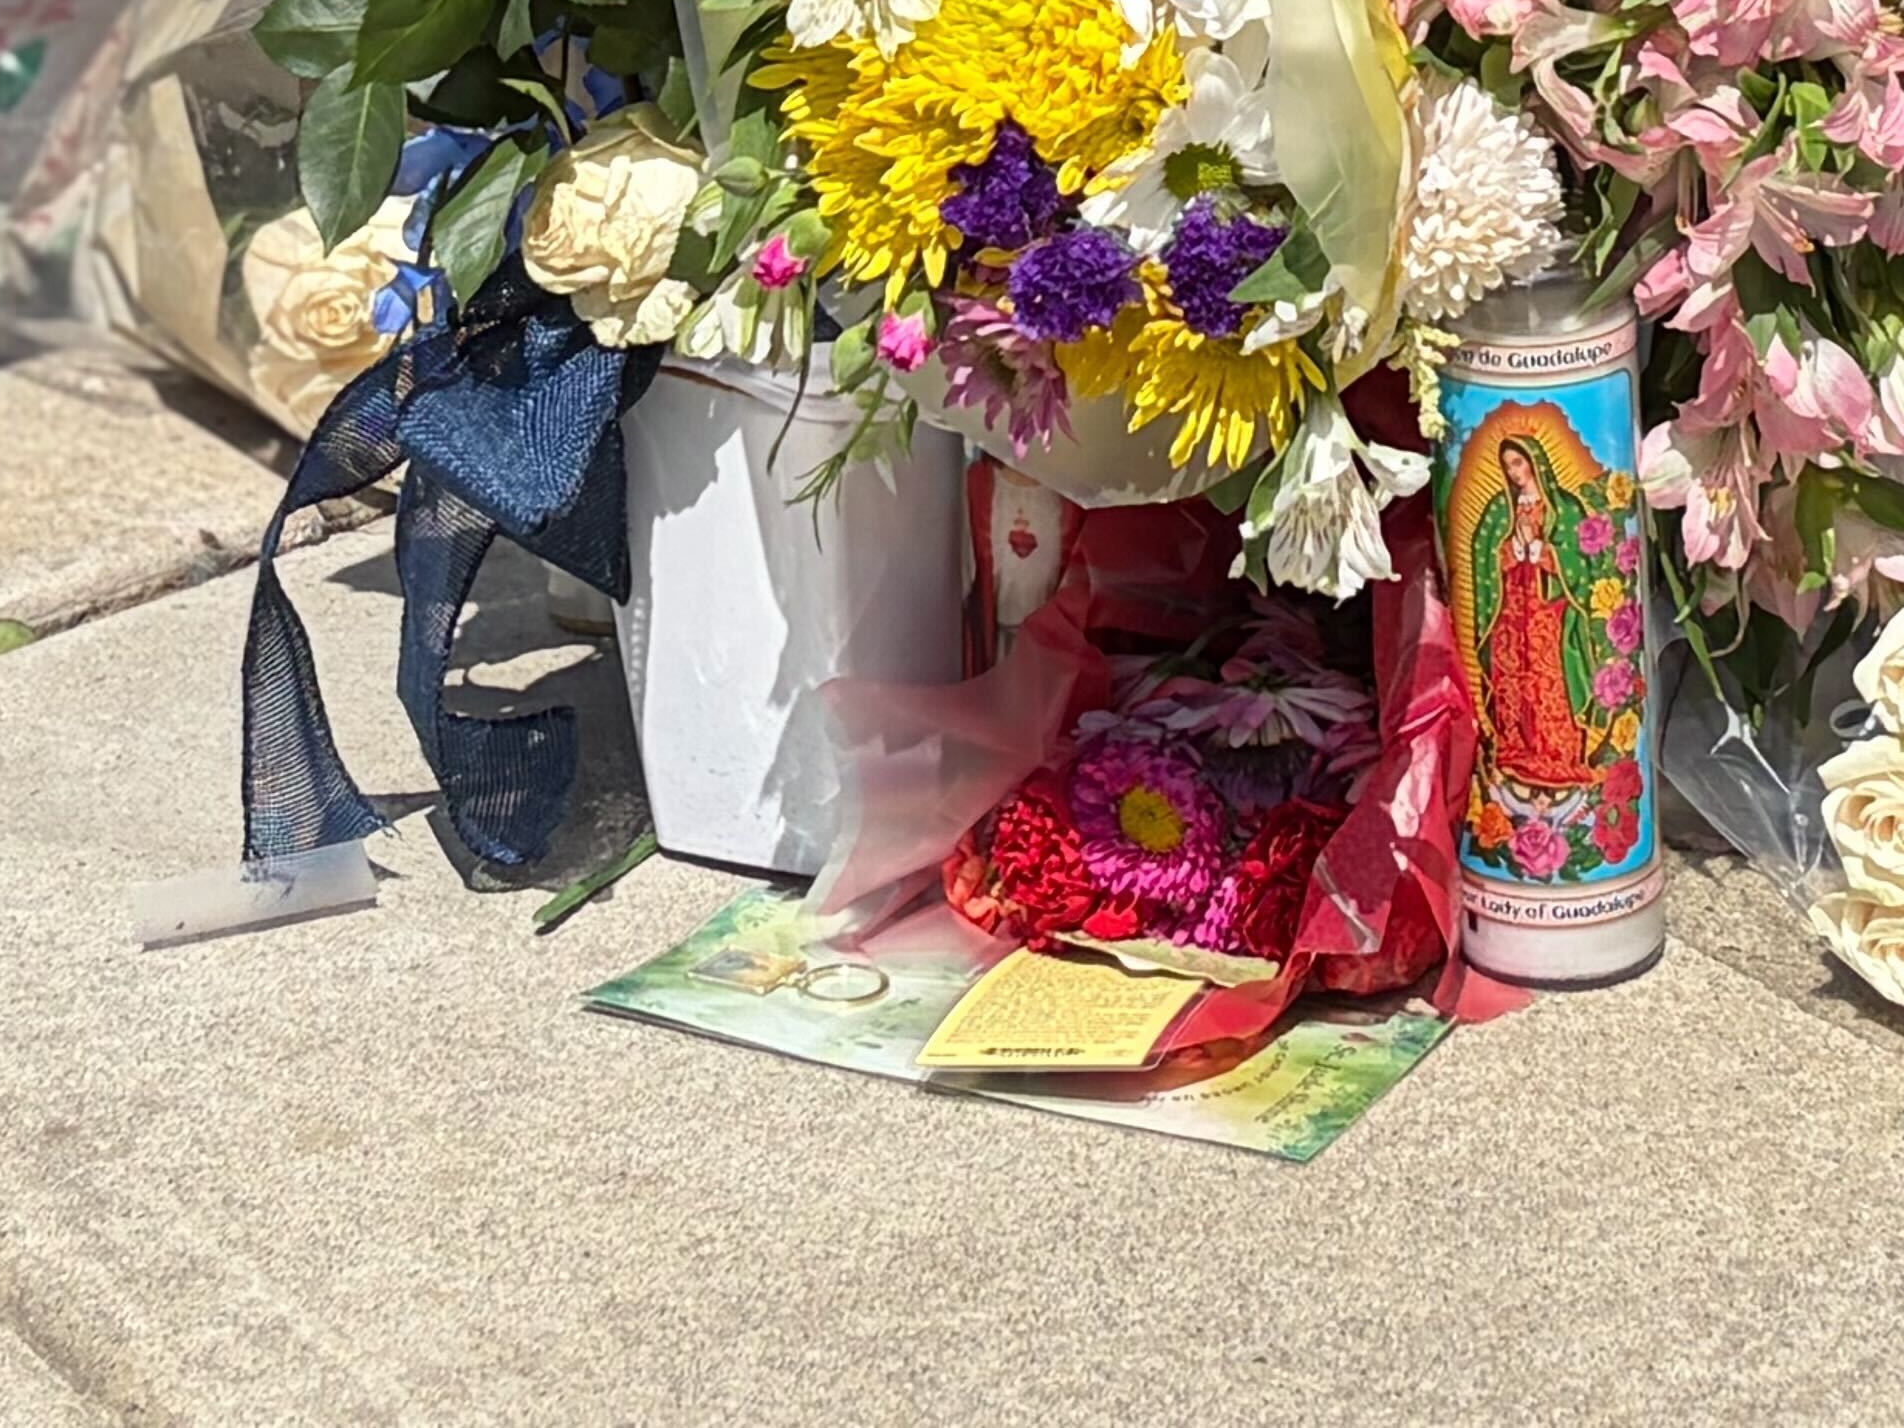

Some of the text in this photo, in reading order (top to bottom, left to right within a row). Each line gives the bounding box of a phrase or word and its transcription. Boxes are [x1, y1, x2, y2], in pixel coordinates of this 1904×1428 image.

[1507, 341, 1613, 370] Guadalupe
[1481, 895, 1521, 920] Lady
[1524, 904, 1546, 920] of
[1551, 889, 1646, 920] Guadalupe
